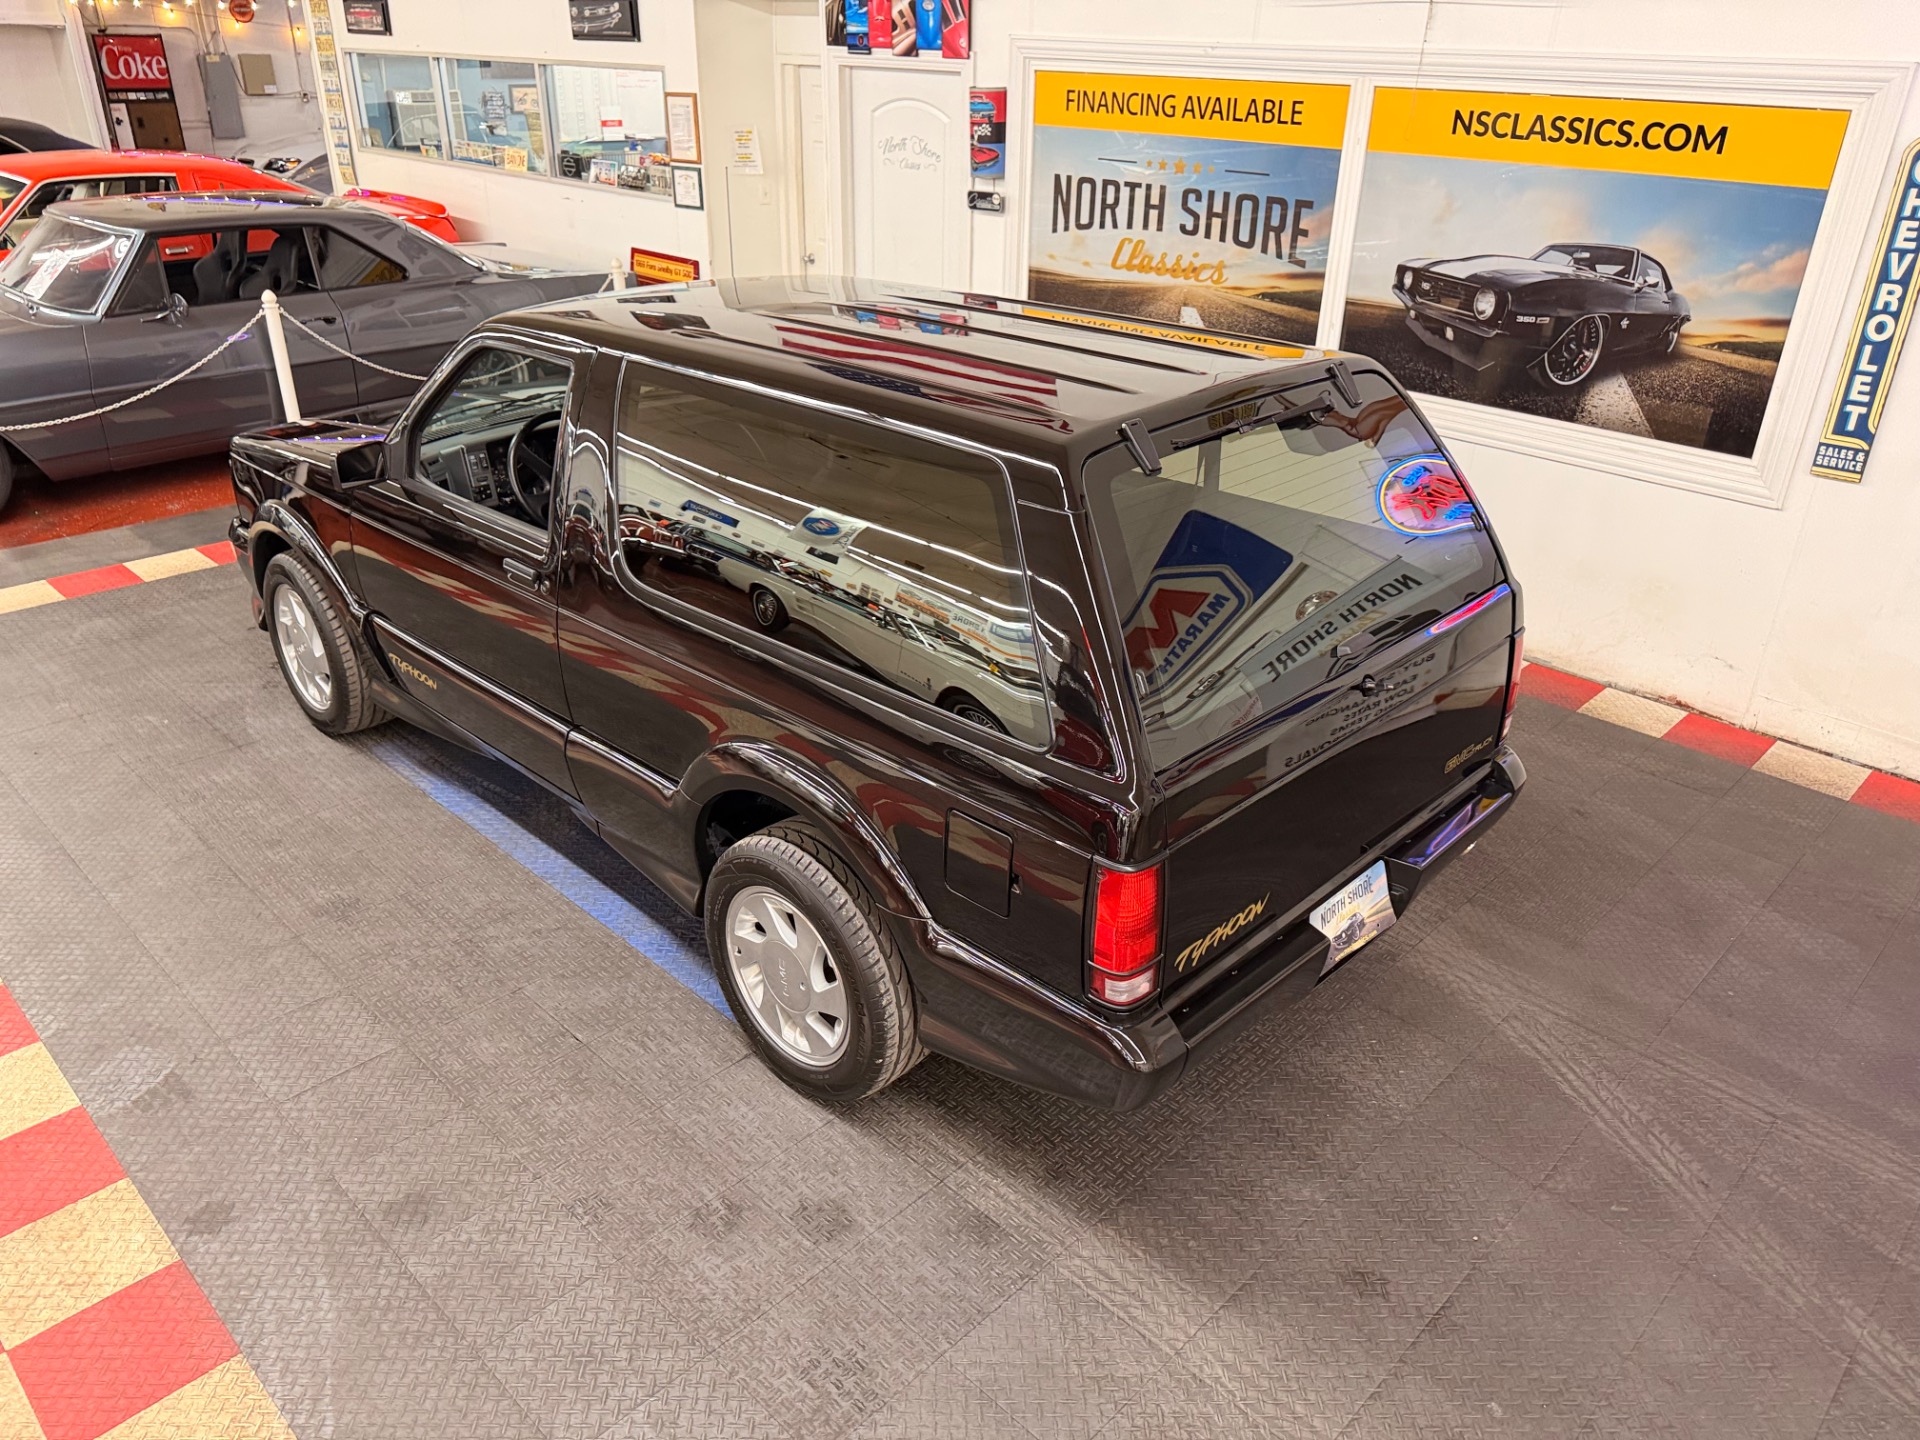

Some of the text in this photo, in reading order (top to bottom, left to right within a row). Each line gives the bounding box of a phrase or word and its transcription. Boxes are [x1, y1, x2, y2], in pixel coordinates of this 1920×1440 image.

[101, 44, 168, 80] Coke
[1065, 90, 1304, 126] FINANCING AVAILABLE
[1451, 109, 1729, 155] NSCLASSICS.COM
[1052, 173, 1314, 269] NORTH SHORE
[1110, 237, 1229, 286] Classics
[1815, 455, 1863, 472] SERVICE
[1819, 446, 1866, 461] SALES &
[388, 653, 437, 690] TYPHOON
[1320, 876, 1374, 930] NORTH SHORE
[1175, 891, 1271, 973] TYPHOON
